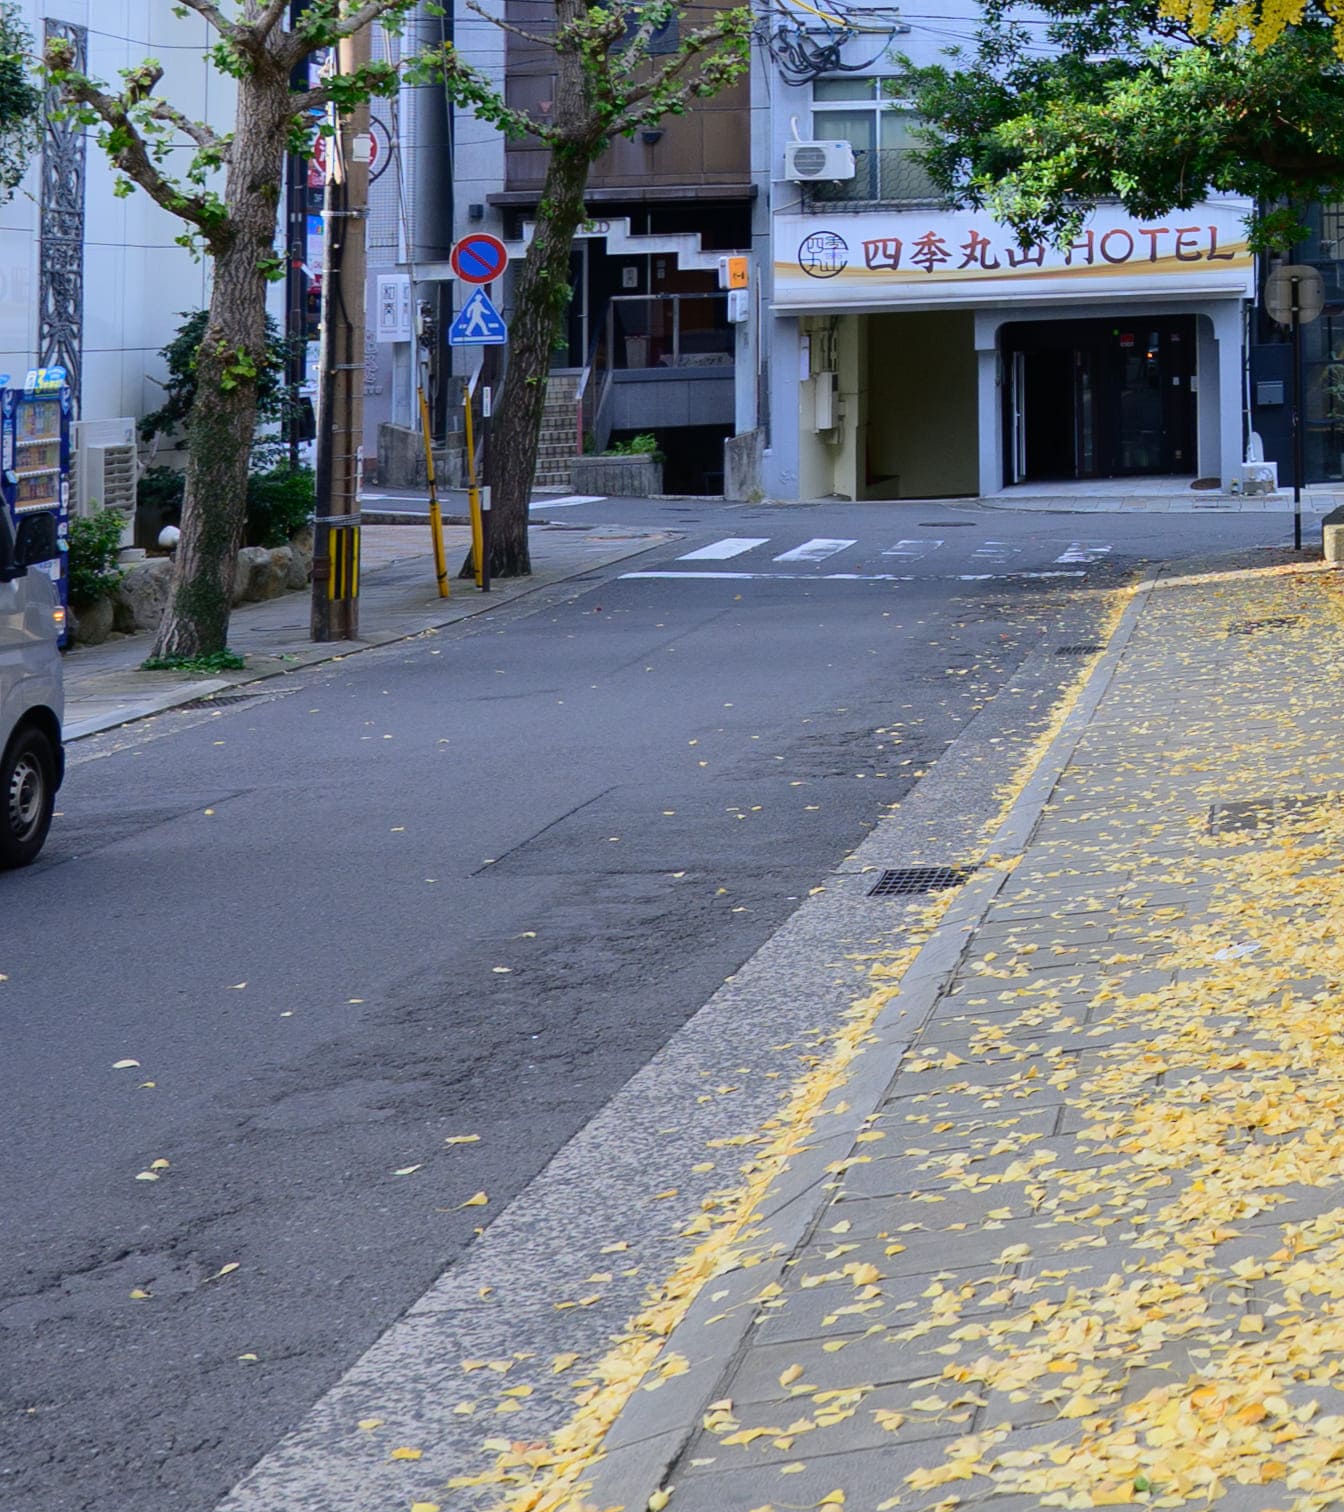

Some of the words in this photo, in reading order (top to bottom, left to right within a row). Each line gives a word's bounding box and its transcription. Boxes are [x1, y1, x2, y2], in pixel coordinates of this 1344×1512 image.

[861, 230, 1046, 273] 四季丸山
[1064, 225, 1235, 266] HOTEL
